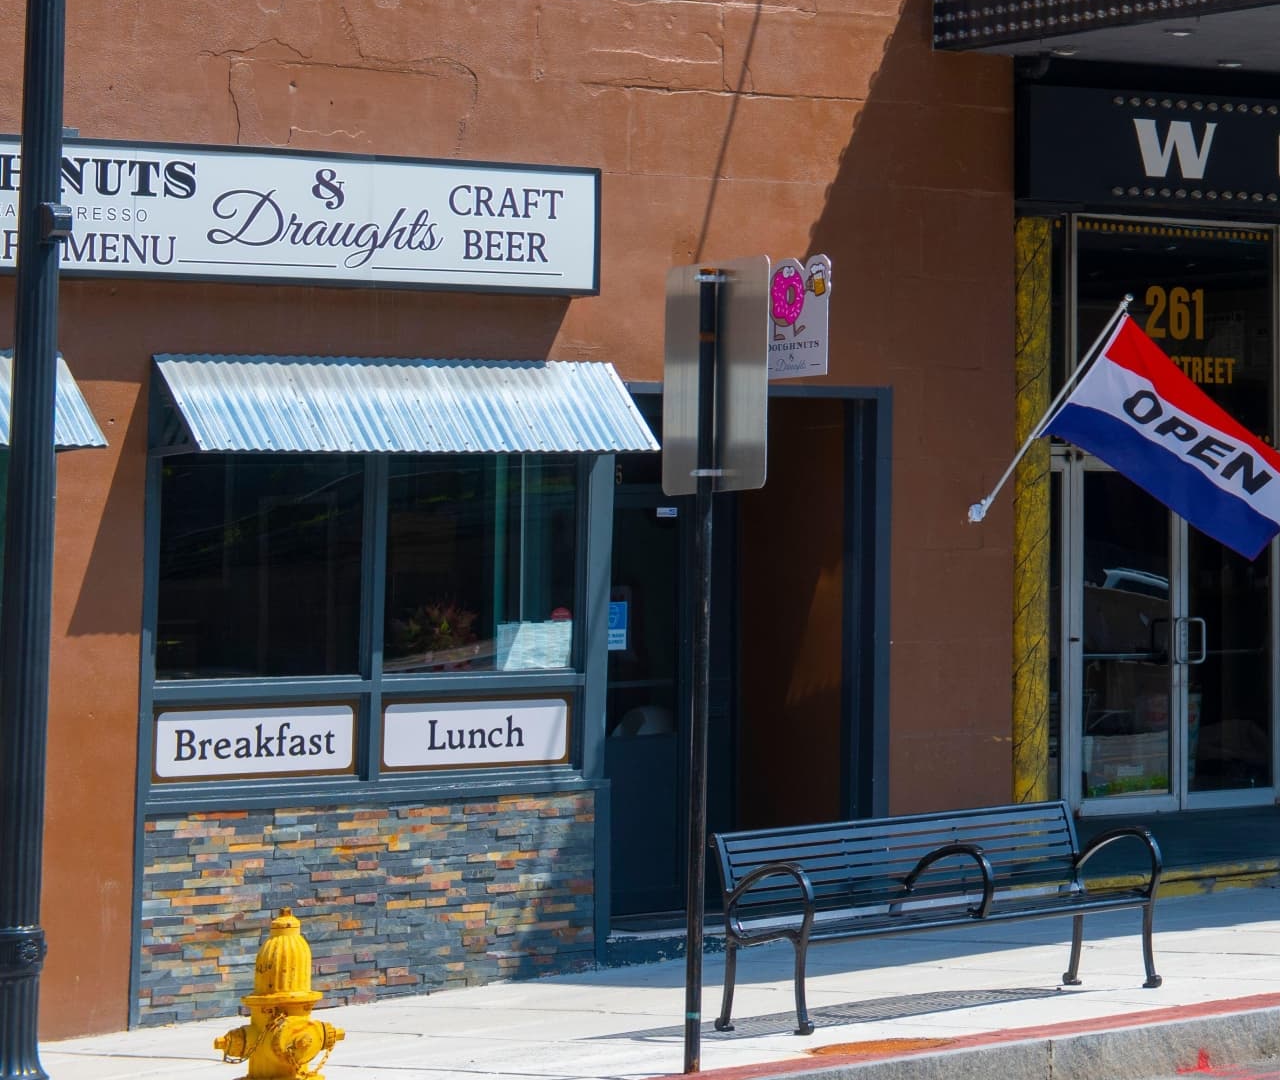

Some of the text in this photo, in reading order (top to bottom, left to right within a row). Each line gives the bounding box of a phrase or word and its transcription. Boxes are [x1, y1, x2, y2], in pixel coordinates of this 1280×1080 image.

[311, 168, 345, 210] &
[448, 184, 564, 220] CRAFT
[206, 189, 443, 269] Draughts
[463, 229, 549, 263] BEER
[62, 232, 176, 265] MENU
[1145, 285, 1204, 340] 261
[768, 340, 819, 352] OUGHNUTS
[1122, 390, 1272, 495] OPEN
[173, 722, 336, 762] Breakfast
[427, 715, 526, 752] Lunch
